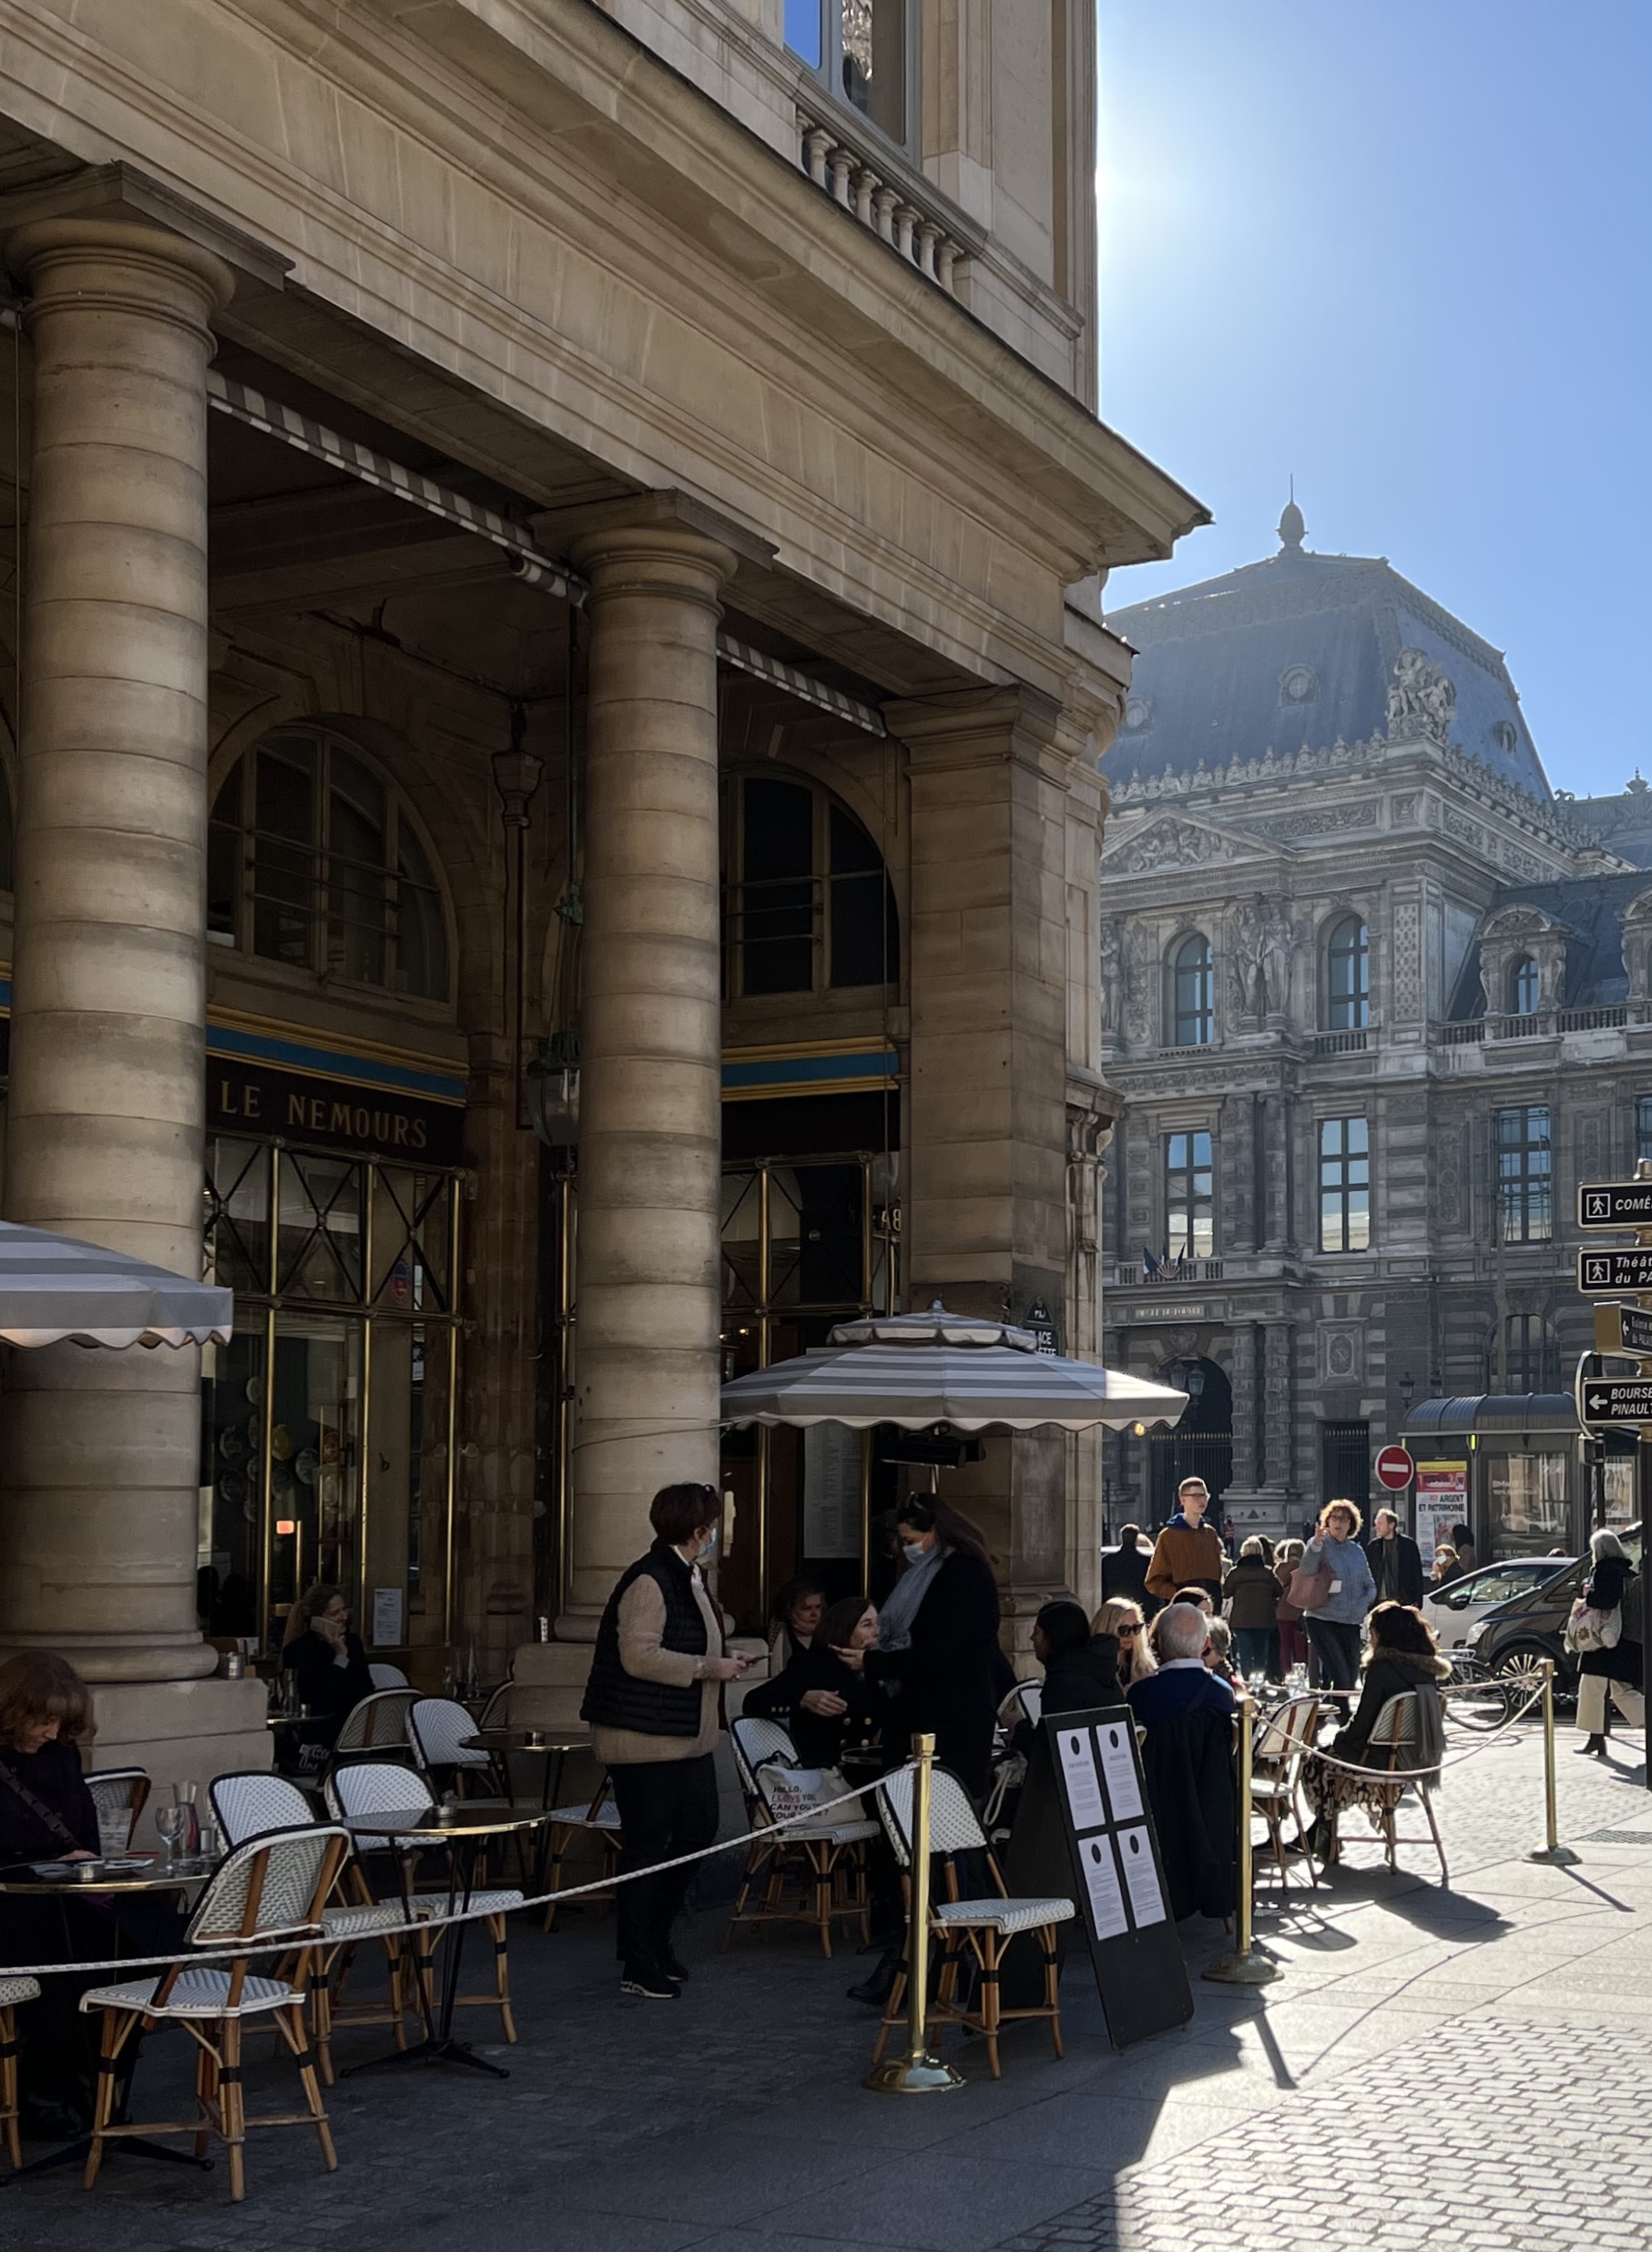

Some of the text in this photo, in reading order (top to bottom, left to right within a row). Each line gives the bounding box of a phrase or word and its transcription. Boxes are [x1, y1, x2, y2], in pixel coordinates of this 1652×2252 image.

[220, 1080, 427, 1148] LE NEMOURS
[1615, 1195, 1652, 1211] COMÉ
[1615, 1272, 1631, 1284] du
[1611, 1387, 1652, 1400] BOURSE
[1439, 1494, 1464, 1503] ARGENT
[1418, 1503, 1464, 1513] ET PATRIMOINE
[794, 1803, 811, 1811] YOU
